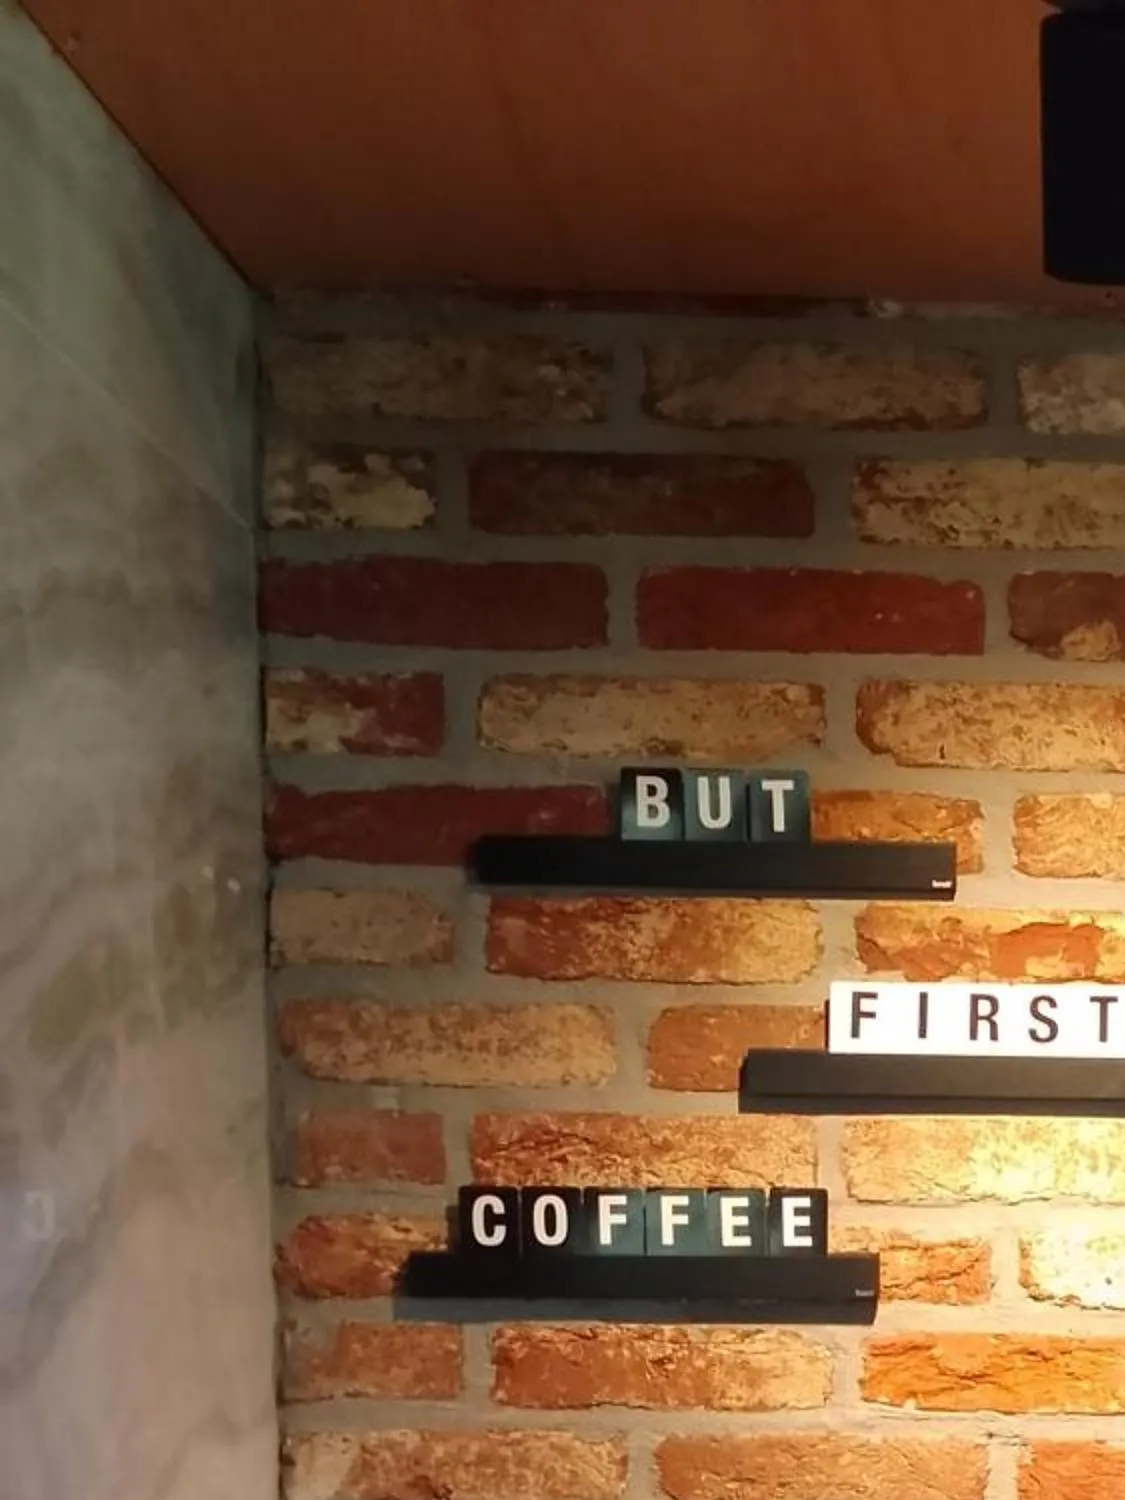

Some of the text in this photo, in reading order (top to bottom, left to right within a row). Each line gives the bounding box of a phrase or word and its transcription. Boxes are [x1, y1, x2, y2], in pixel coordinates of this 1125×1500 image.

[635, 775, 795, 833] BUT
[850, 992, 1119, 1045] FIRST
[471, 1195, 814, 1248] COFFEE
